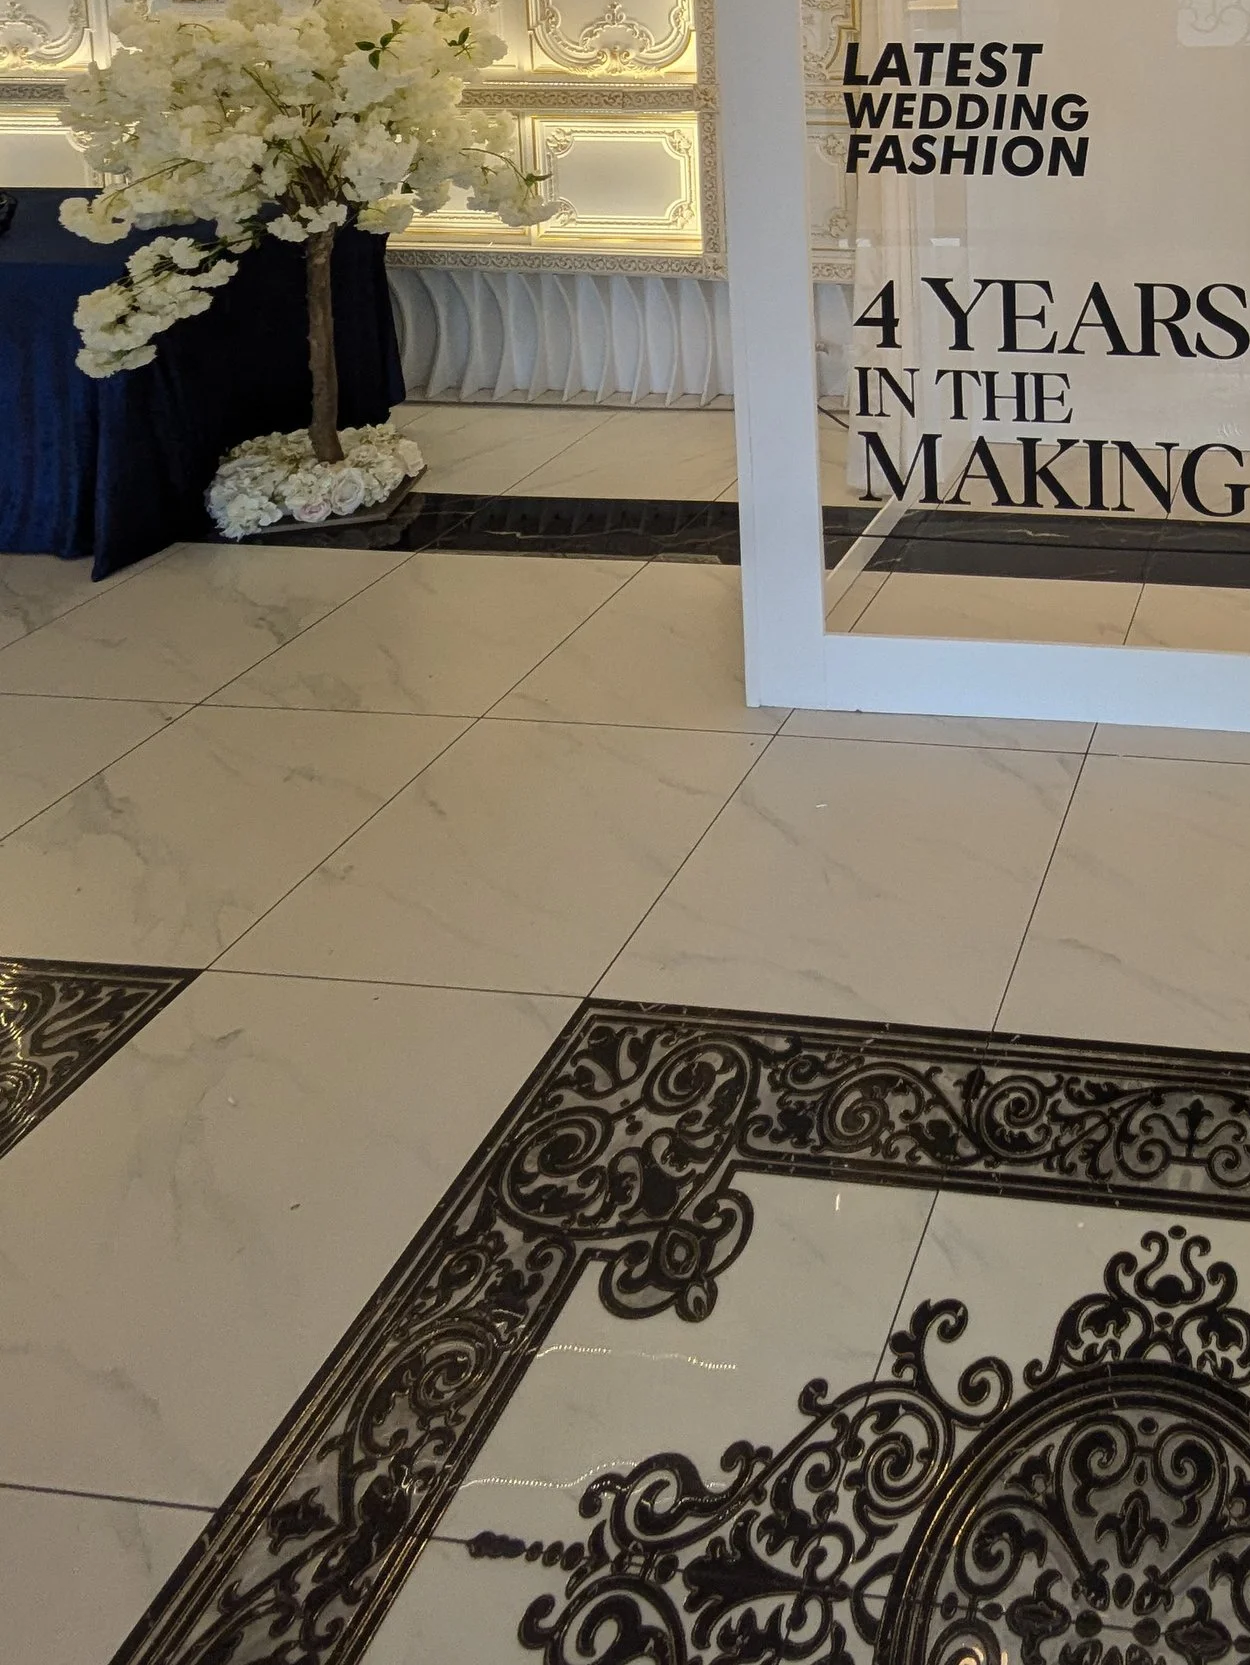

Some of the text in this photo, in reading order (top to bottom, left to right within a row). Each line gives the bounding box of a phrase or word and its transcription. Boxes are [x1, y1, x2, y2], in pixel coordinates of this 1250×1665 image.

[843, 42, 1043, 87] LATEST
[844, 93, 1089, 132] WEDDING
[846, 134, 1090, 177] FASHION
[853, 277, 1250, 360] 4 YEARS
[855, 366, 1074, 424] IN THE
